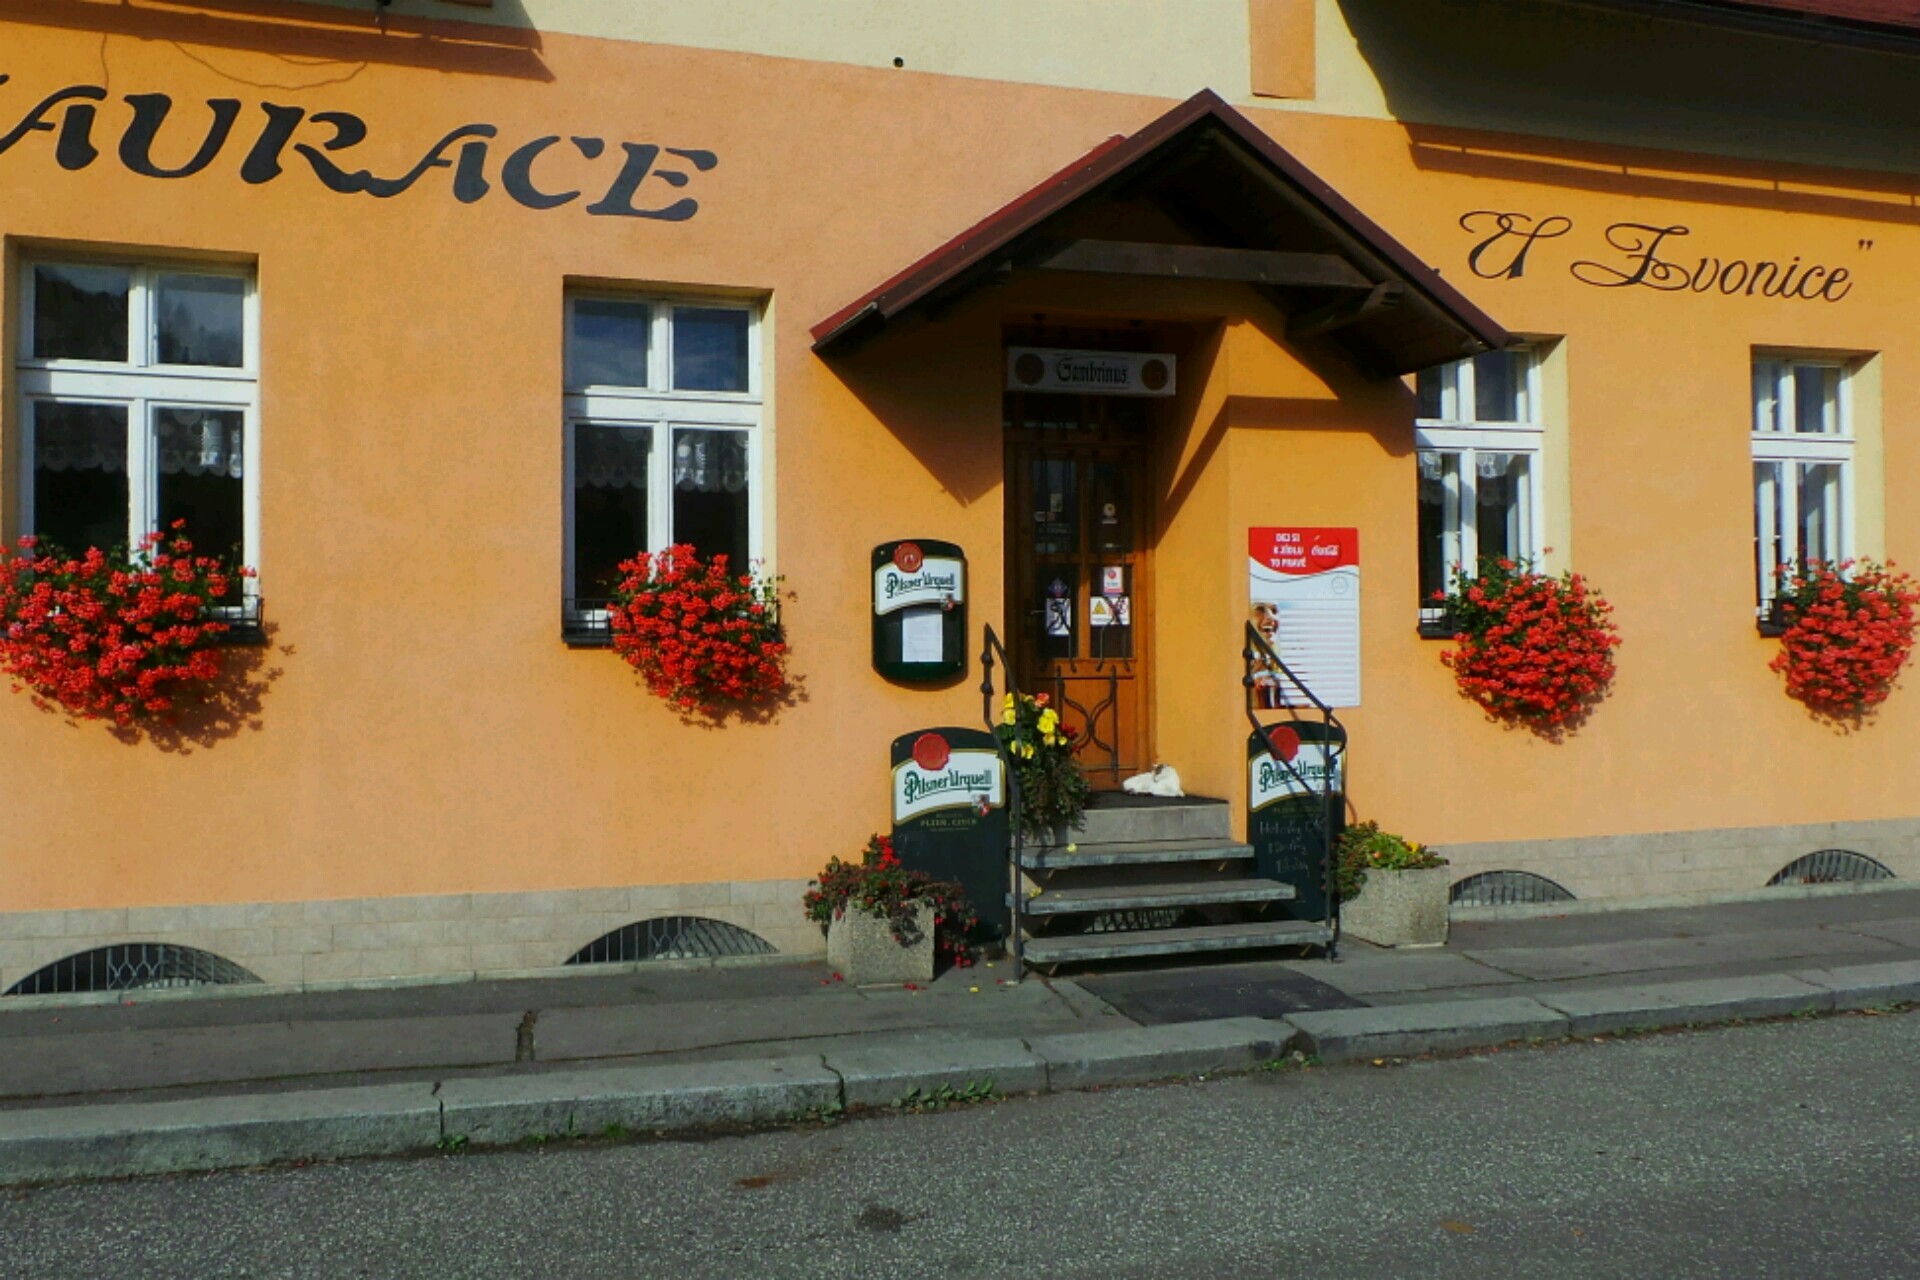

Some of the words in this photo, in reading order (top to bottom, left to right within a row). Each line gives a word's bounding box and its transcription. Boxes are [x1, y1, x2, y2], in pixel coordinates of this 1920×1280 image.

[0, 75, 718, 222] AURACE
[885, 572, 923, 599] Pilsner
[922, 571, 955, 591] Urquell
[903, 770, 948, 804] Pilsner
[948, 768, 993, 793] Urquell
